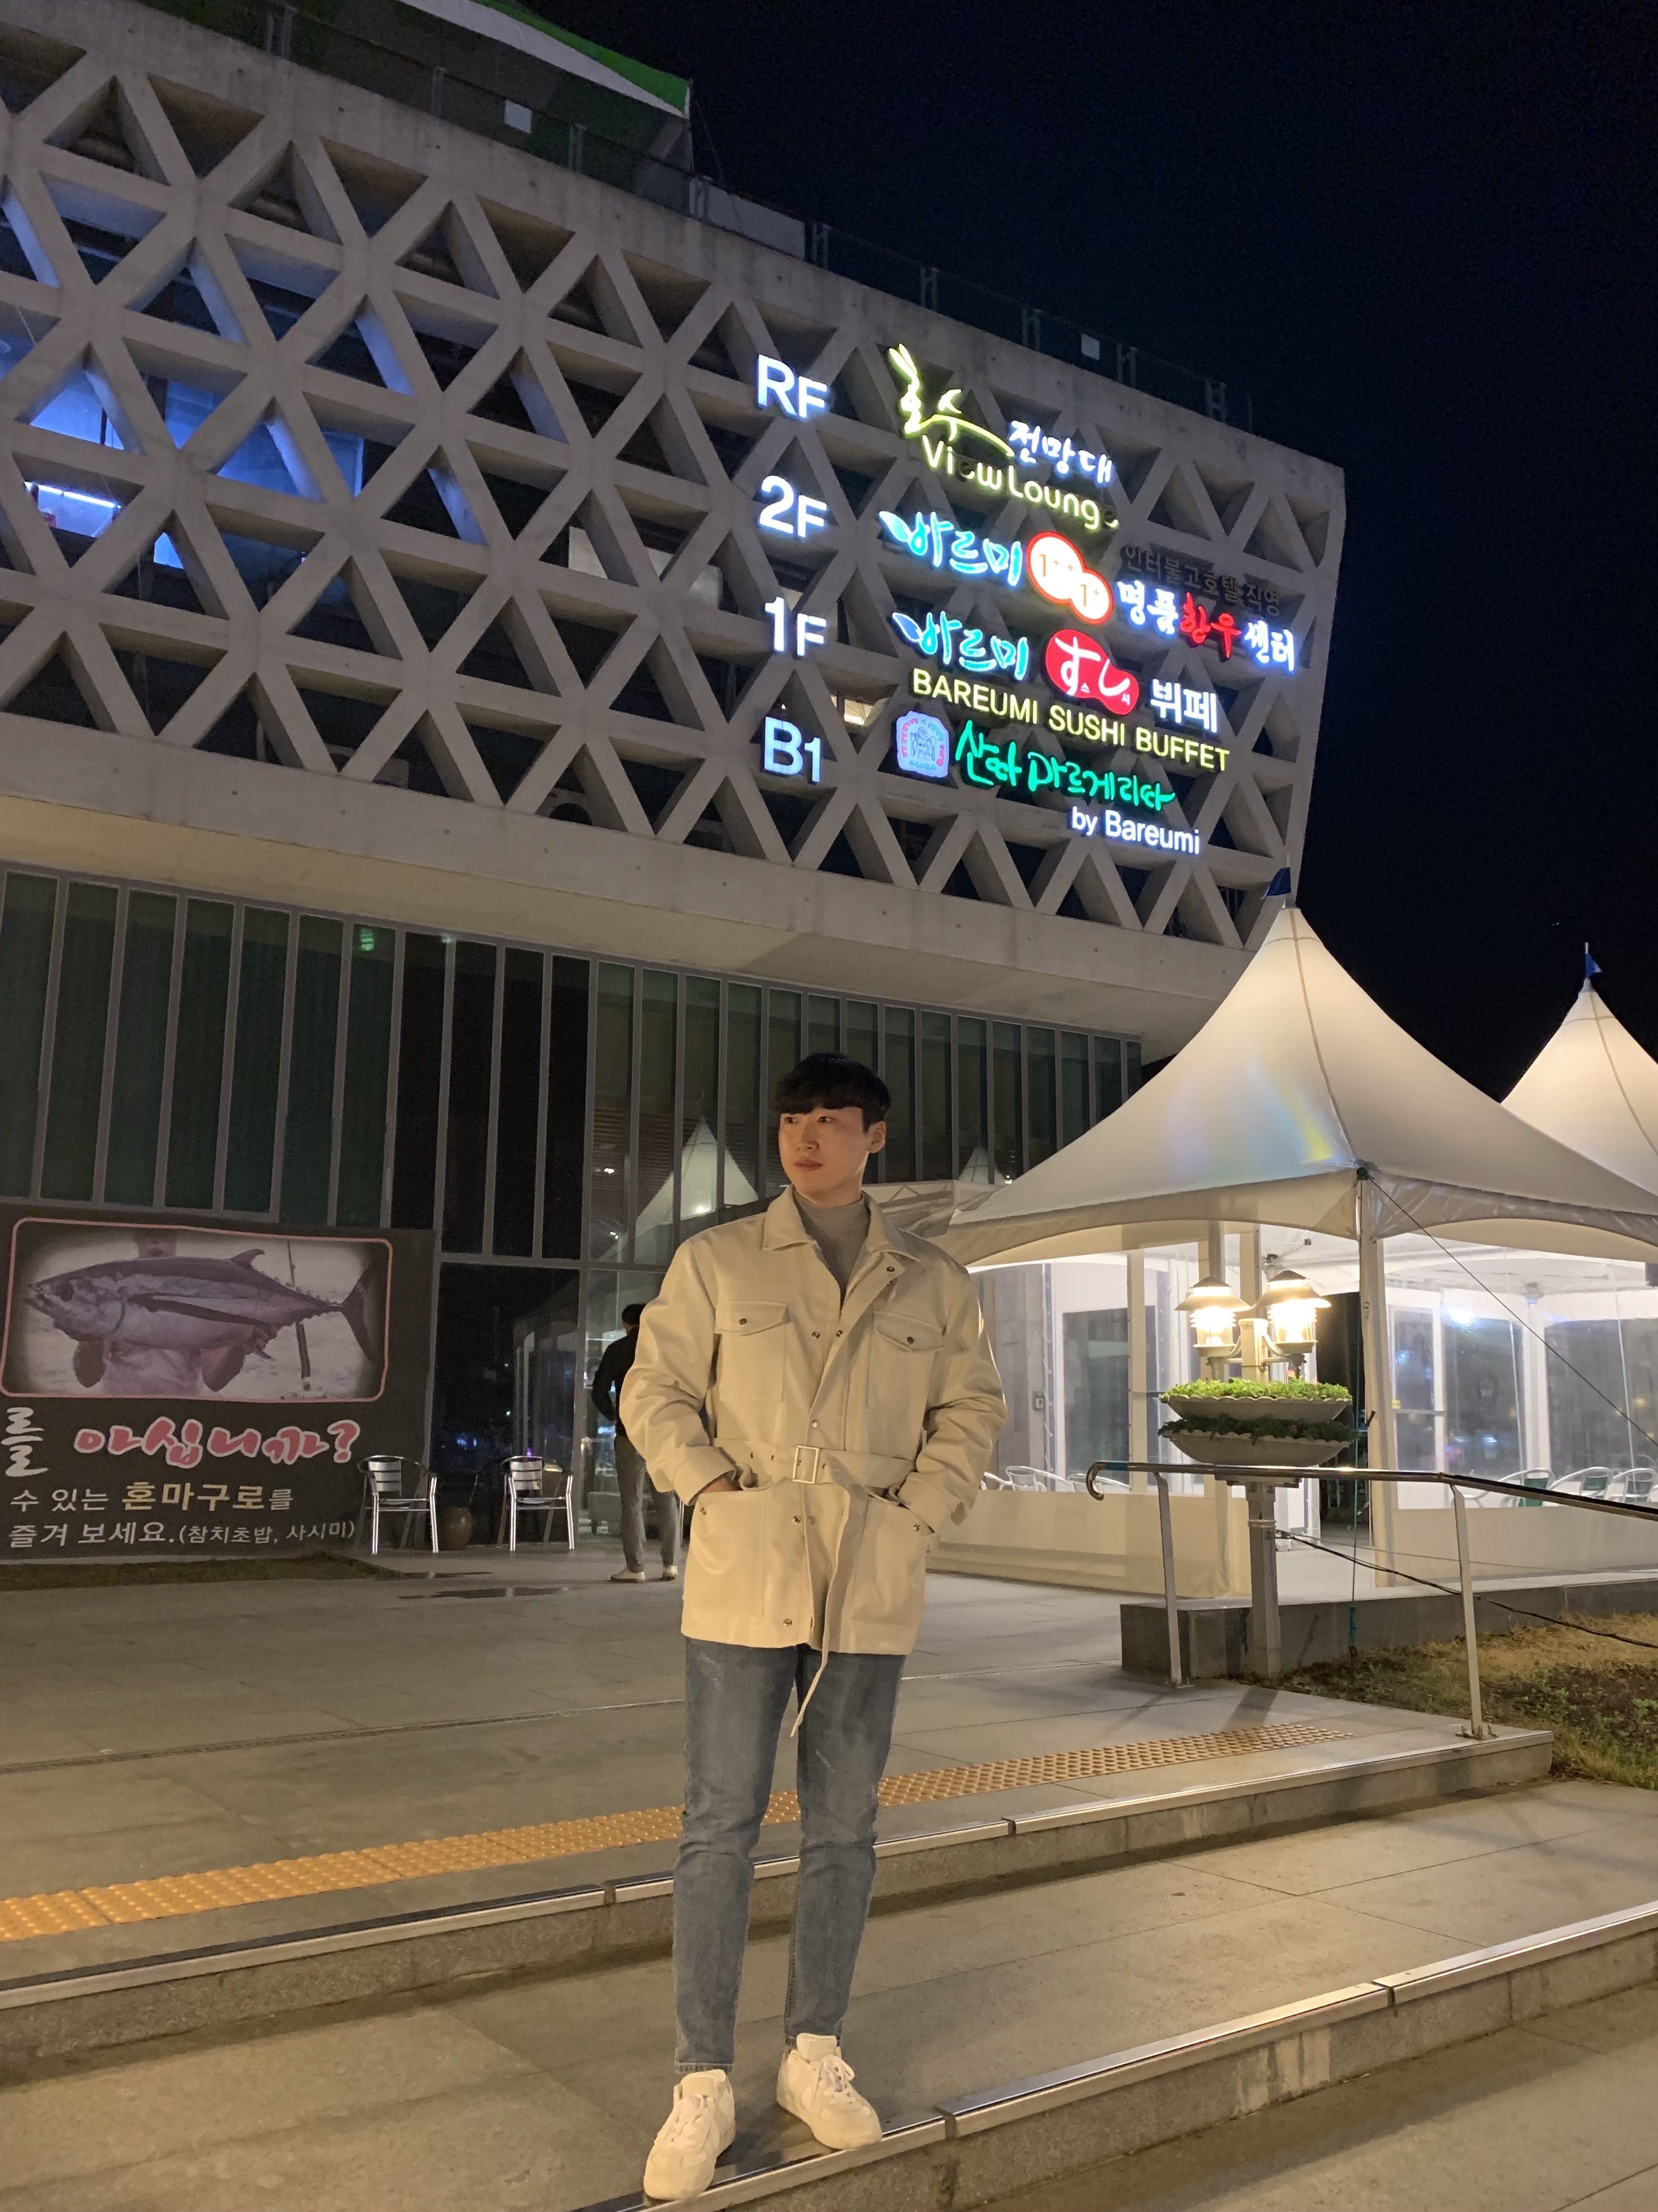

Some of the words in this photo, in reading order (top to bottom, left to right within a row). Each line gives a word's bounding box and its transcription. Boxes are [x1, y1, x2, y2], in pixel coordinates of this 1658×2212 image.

[757, 354, 828, 418] RF
[1010, 420, 1114, 482] 전망대
[759, 475, 828, 538] 2F
[879, 510, 1023, 587] 바르미
[765, 596, 826, 657] 1F
[892, 610, 1029, 680] 바르미
[1054, 636, 1130, 697] すし
[913, 667, 1038, 725] BAREUMI
[1048, 705, 1125, 747] SUSHI
[1135, 727, 1230, 772] BUFFET
[1150, 679, 1217, 734] 뷔페
[764, 716, 821, 782] B1
[1071, 806, 1098, 836] by
[1105, 810, 1200, 854] Bareumi
[1, 1407, 49, 1478] 를
[74, 1416, 361, 1469] 아십니까?
[11, 1489, 39, 1512] 수
[51, 1488, 109, 1511] 있는
[122, 1482, 293, 1511] 혼마구로를
[9, 1523, 68, 1547] 즐겨
[285, 1520, 355, 1541] 사시미)
